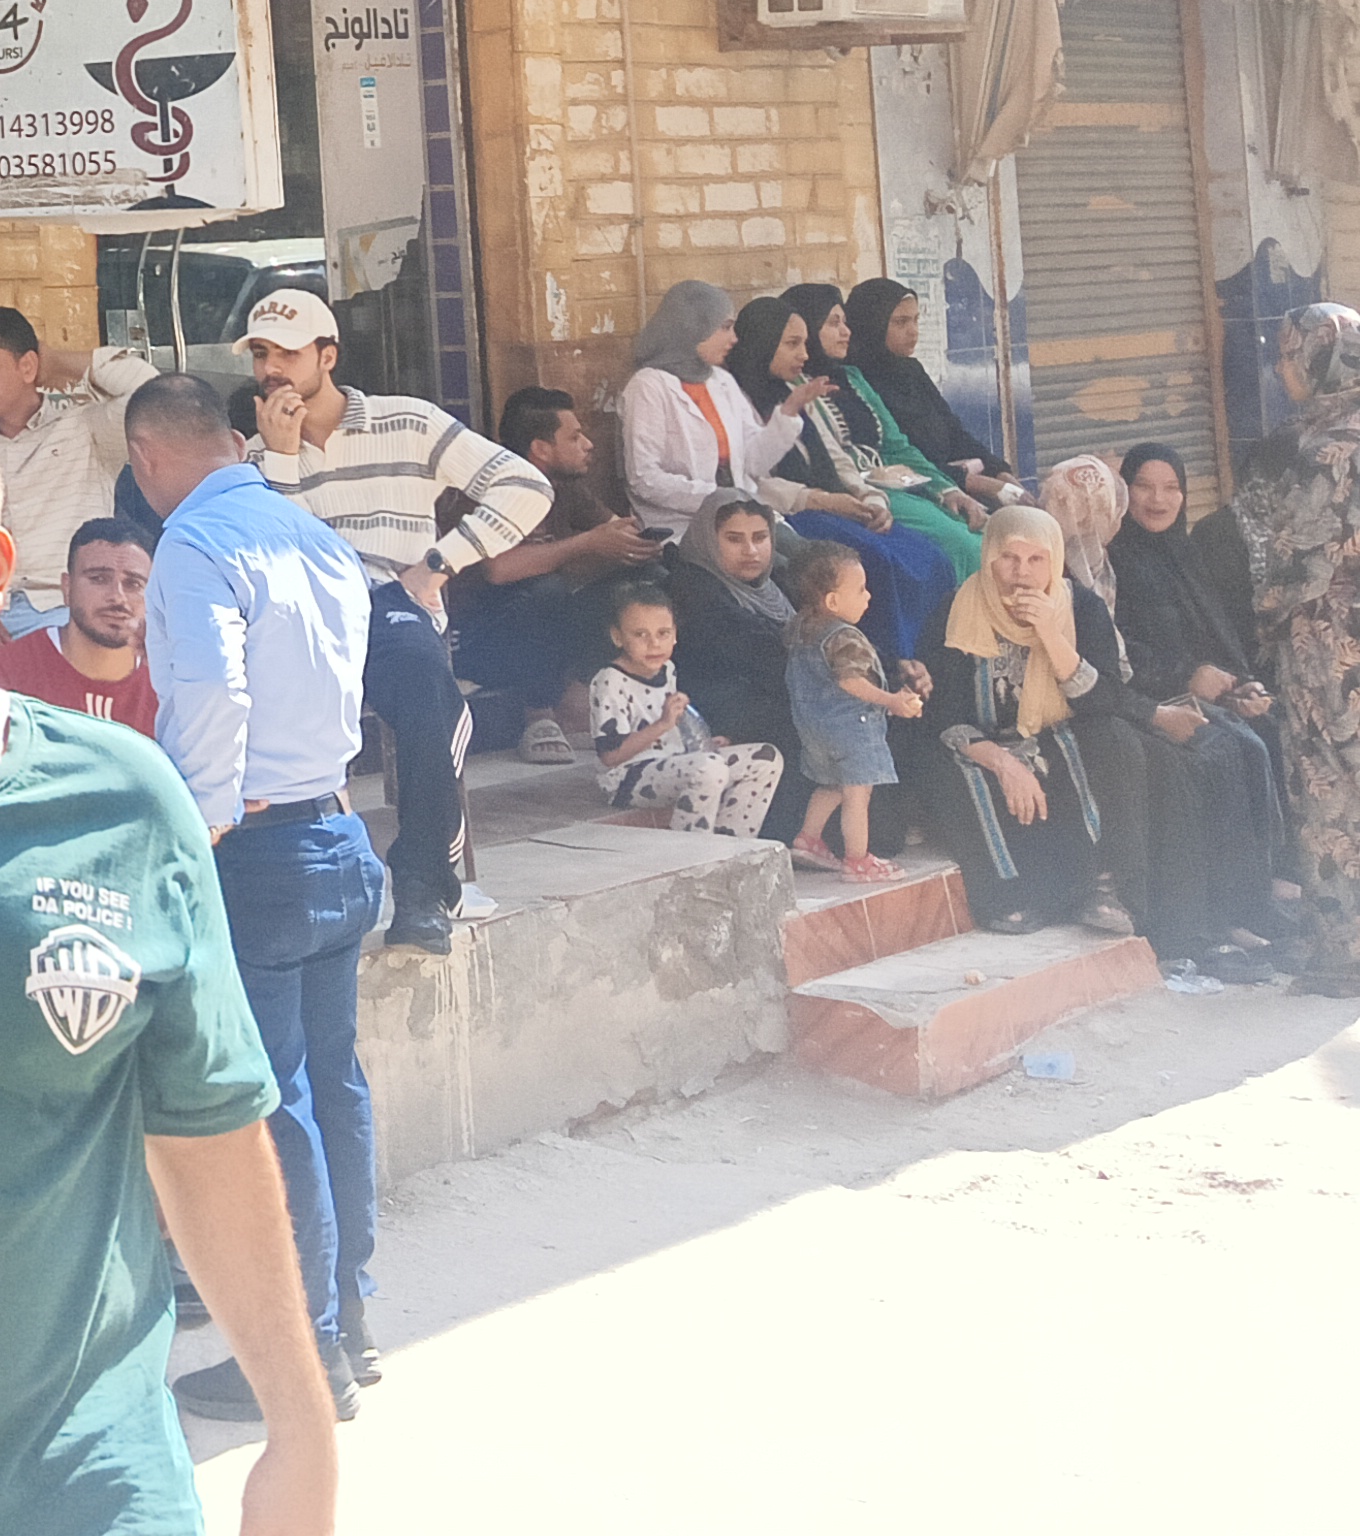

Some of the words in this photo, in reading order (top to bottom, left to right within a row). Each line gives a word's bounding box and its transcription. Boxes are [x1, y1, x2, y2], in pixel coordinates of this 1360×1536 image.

[324, 8, 409, 52] تادالونج
[253, 301, 298, 322] PARIS
[32, 895, 59, 914] DA
[63, 900, 125, 928] POLICE
[36, 877, 58, 894] IF
[59, 879, 95, 902] YOU
[98, 887, 130, 912] SEE
